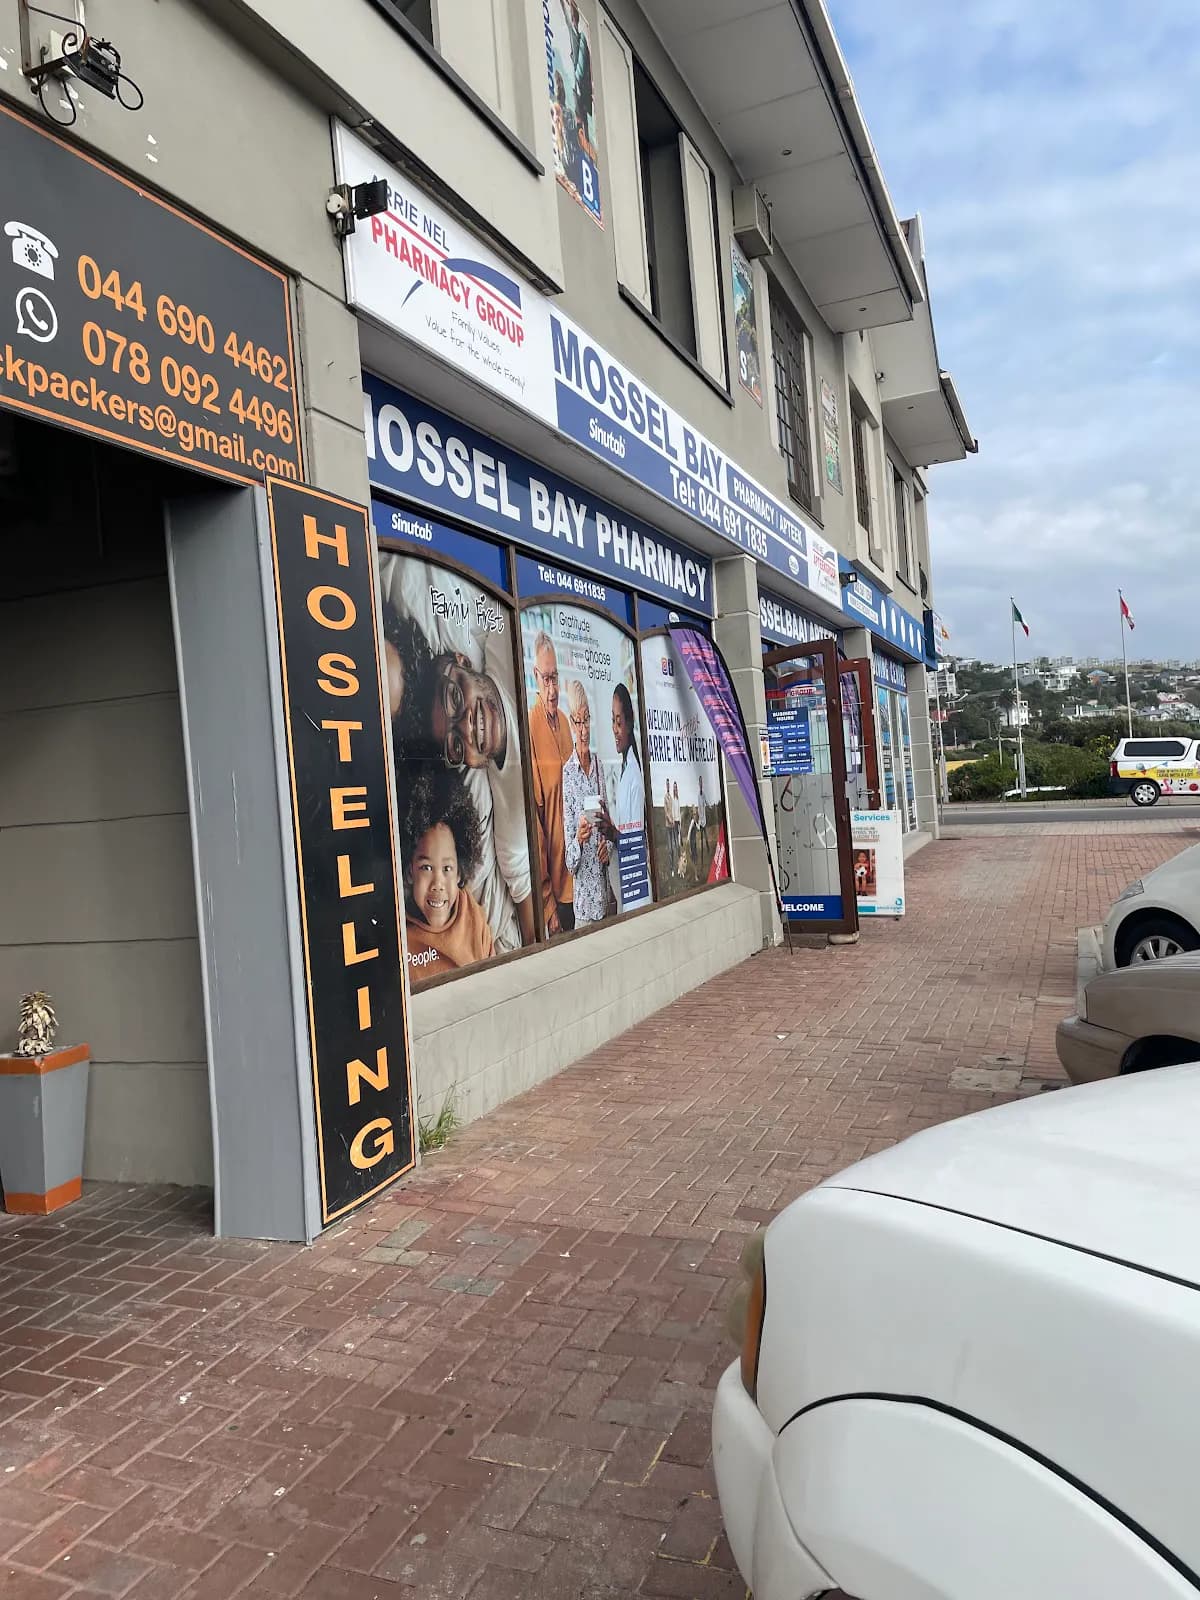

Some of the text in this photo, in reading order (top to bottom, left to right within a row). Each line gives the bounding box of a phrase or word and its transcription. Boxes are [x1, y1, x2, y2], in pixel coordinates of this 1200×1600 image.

[423, 214, 450, 253] NEL
[370, 215, 525, 348] PHARMACY GROUP
[77, 254, 290, 392] 044 690 4462
[425, 313, 448, 338] Value
[468, 344, 480, 360] the
[451, 311, 477, 343] Family
[82, 322, 293, 444] 078 092 4496
[550, 313, 679, 462] MOSSEL
[682, 426, 726, 495] BAY
[588, 417, 626, 459] Sinutab
[391, 512, 433, 542] Sinutab
[670, 463, 768, 558] Tel: 044 691 1835
[733, 476, 803, 545] PHARMACY APTEEK
[529, 477, 587, 549] BAY
[595, 510, 707, 602] PHARMACY
[538, 565, 606, 601] Tel: 044 6911835
[429, 584, 505, 646] Family First
[559, 611, 590, 633] Gratitude
[646, 708, 674, 732] WELKOM
[672, 735, 687, 763] NEL
[853, 814, 891, 822] Services
[303, 513, 394, 1172] HOSTELLING
